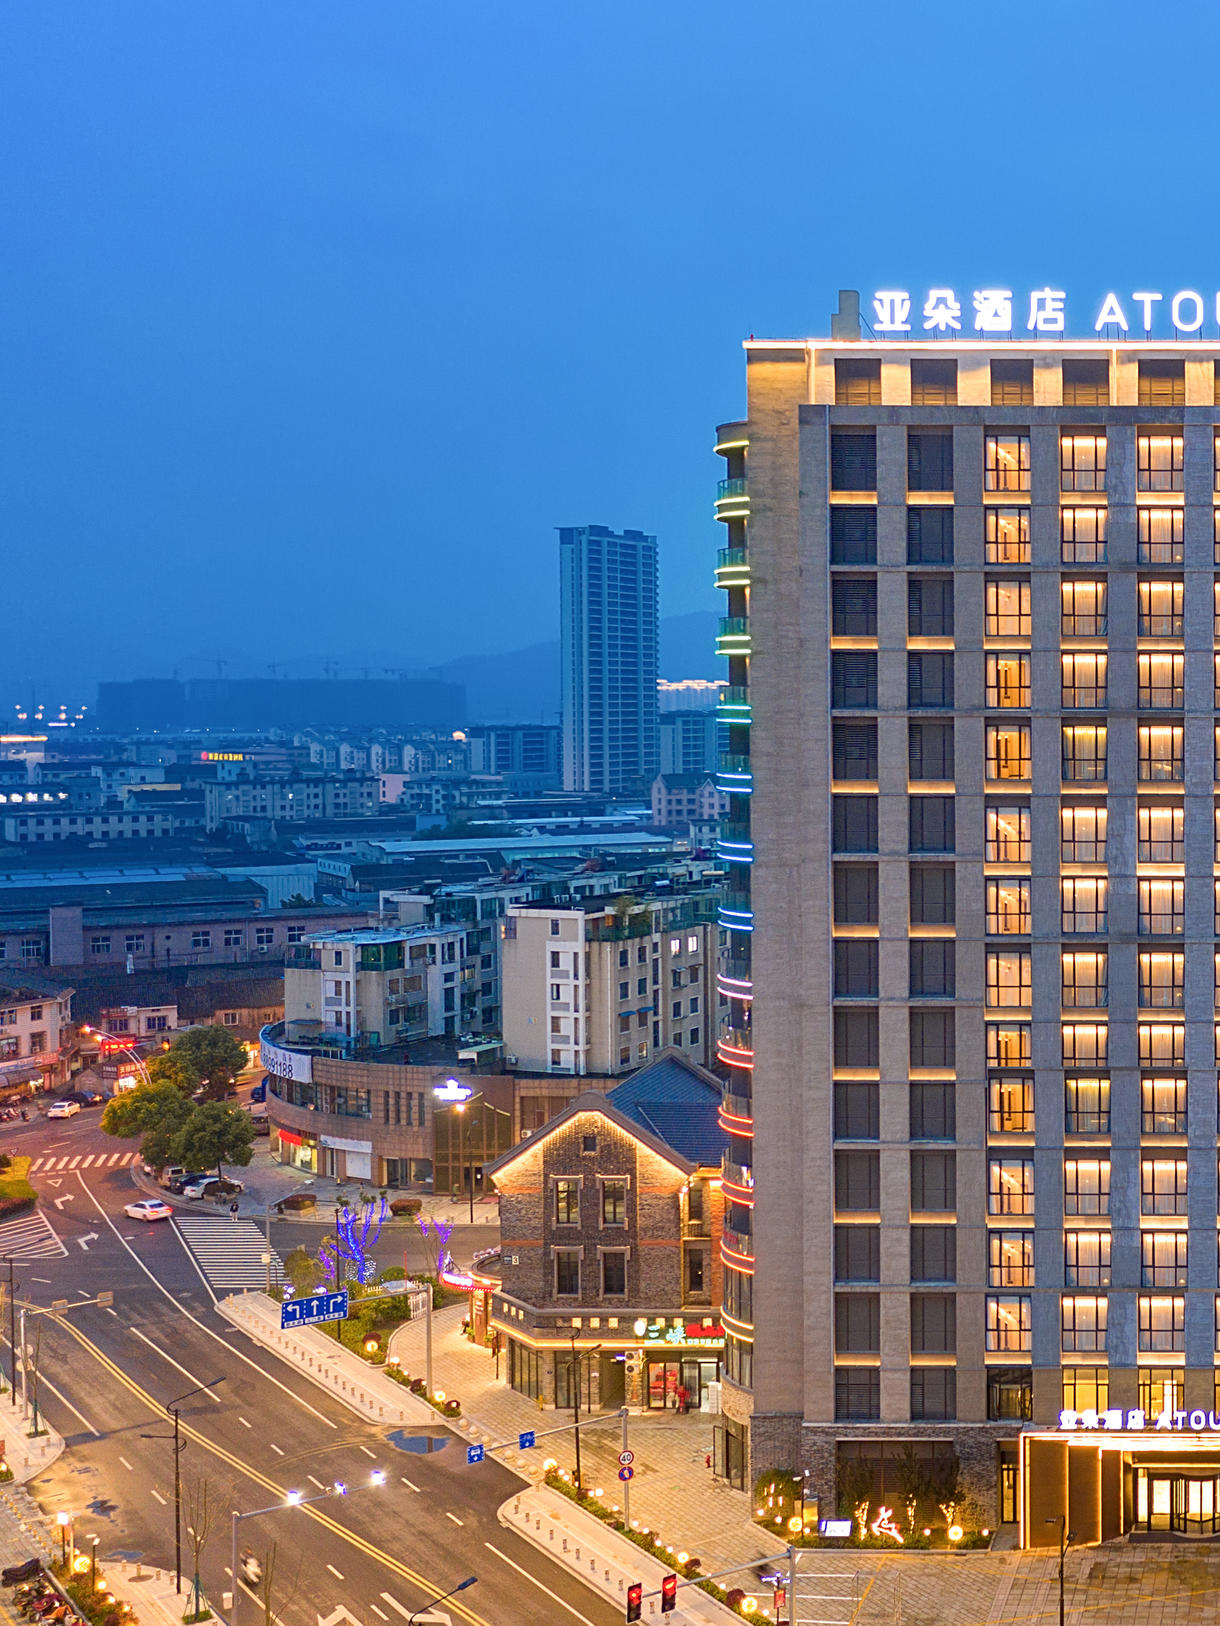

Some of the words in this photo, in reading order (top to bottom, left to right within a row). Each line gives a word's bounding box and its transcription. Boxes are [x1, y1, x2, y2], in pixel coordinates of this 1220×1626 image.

[872, 288, 1068, 333] 亚朵酒店
[621, 1454, 631, 1462] 40
